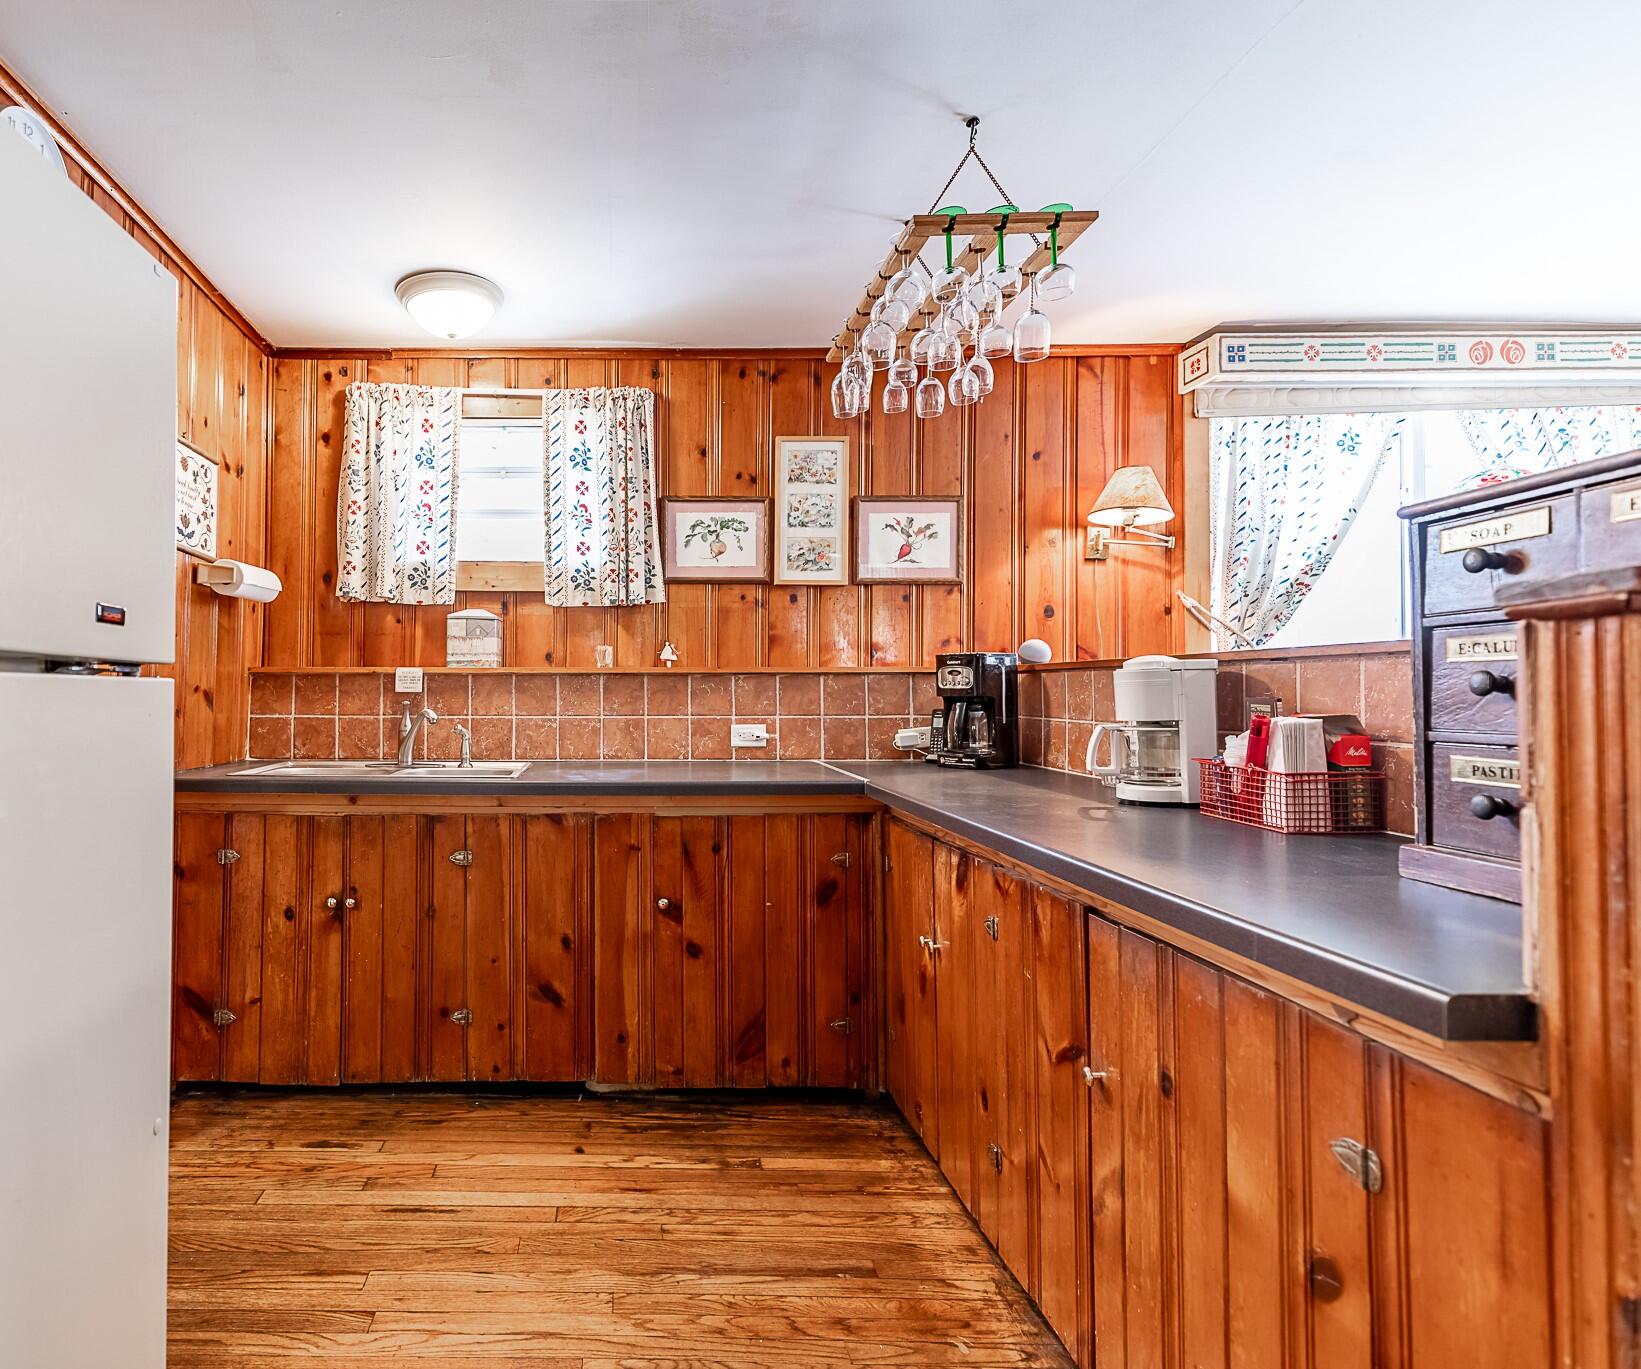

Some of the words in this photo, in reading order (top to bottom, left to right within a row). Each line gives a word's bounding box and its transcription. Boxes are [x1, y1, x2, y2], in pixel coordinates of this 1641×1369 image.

[23, 123, 33, 139] 12
[1470, 523, 1512, 541] SOAP
[1472, 764, 1520, 780] PASTI
